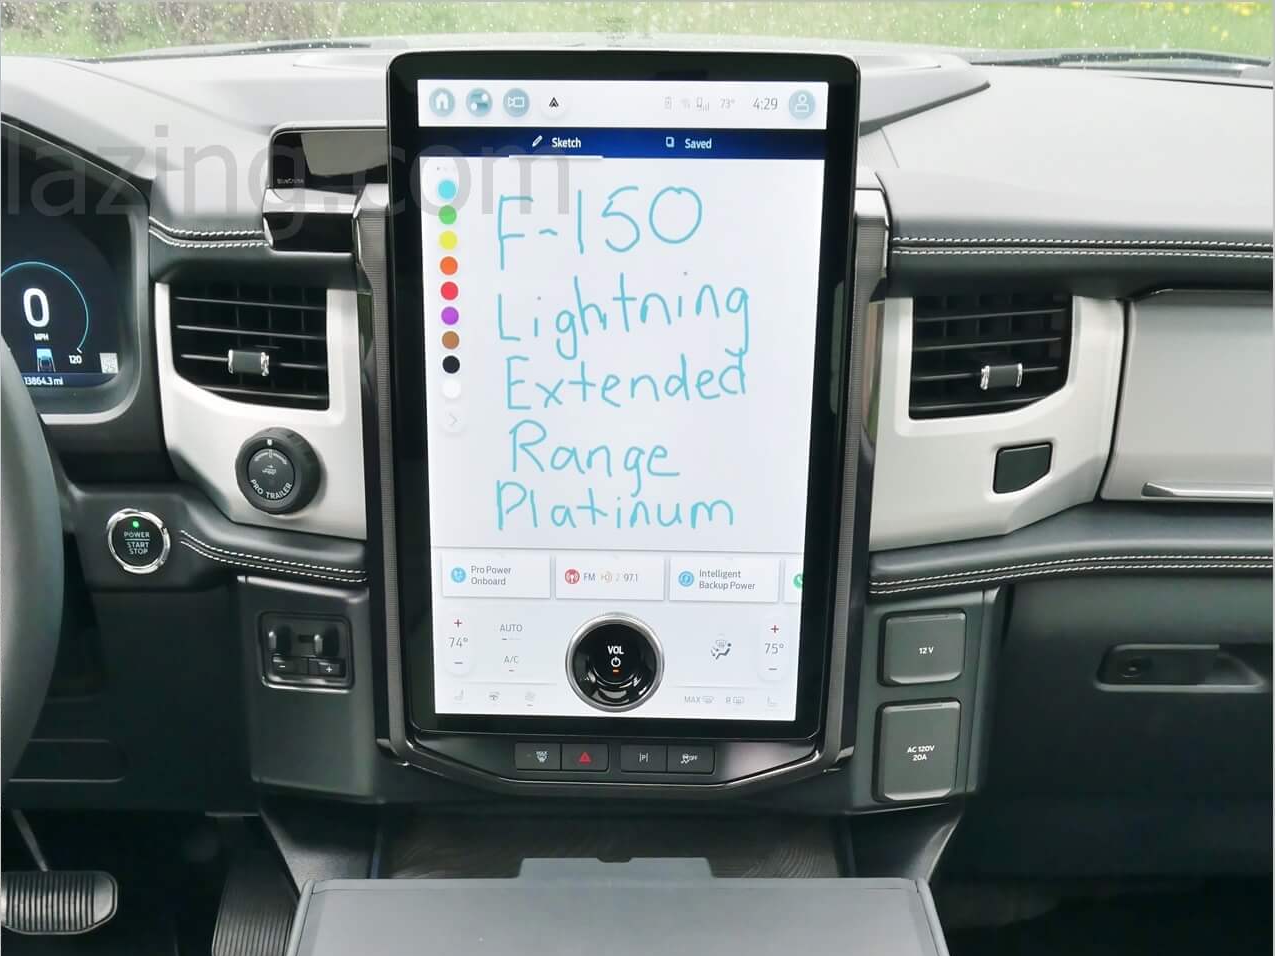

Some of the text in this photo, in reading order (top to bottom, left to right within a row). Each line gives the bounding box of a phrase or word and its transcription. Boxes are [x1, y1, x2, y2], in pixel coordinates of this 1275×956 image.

[752, 97, 778, 111] 4:29
[551, 137, 582, 149] Sketch
[684, 138, 712, 150] Saved
[497, 186, 703, 270] F-150
[23, 287, 50, 328] 0
[498, 272, 750, 360] Lightning
[34, 332, 50, 342] MPH
[68, 355, 83, 365] 120
[505, 352, 747, 411] Extended
[508, 420, 680, 498] Range
[250, 478, 293, 500] PRO TRAILER
[496, 479, 734, 531] Platinum
[470, 566, 512, 575] Pro Power
[699, 569, 741, 580] Intelligent
[470, 577, 507, 586] Onboard
[583, 572, 596, 581] FM
[699, 580, 756, 591] Backup Power
[499, 623, 523, 633] AUTO
[607, 645, 624, 655] VOL
[503, 655, 519, 664] A/C
[907, 744, 935, 754] AC 120V
[912, 754, 928, 762] 20A
